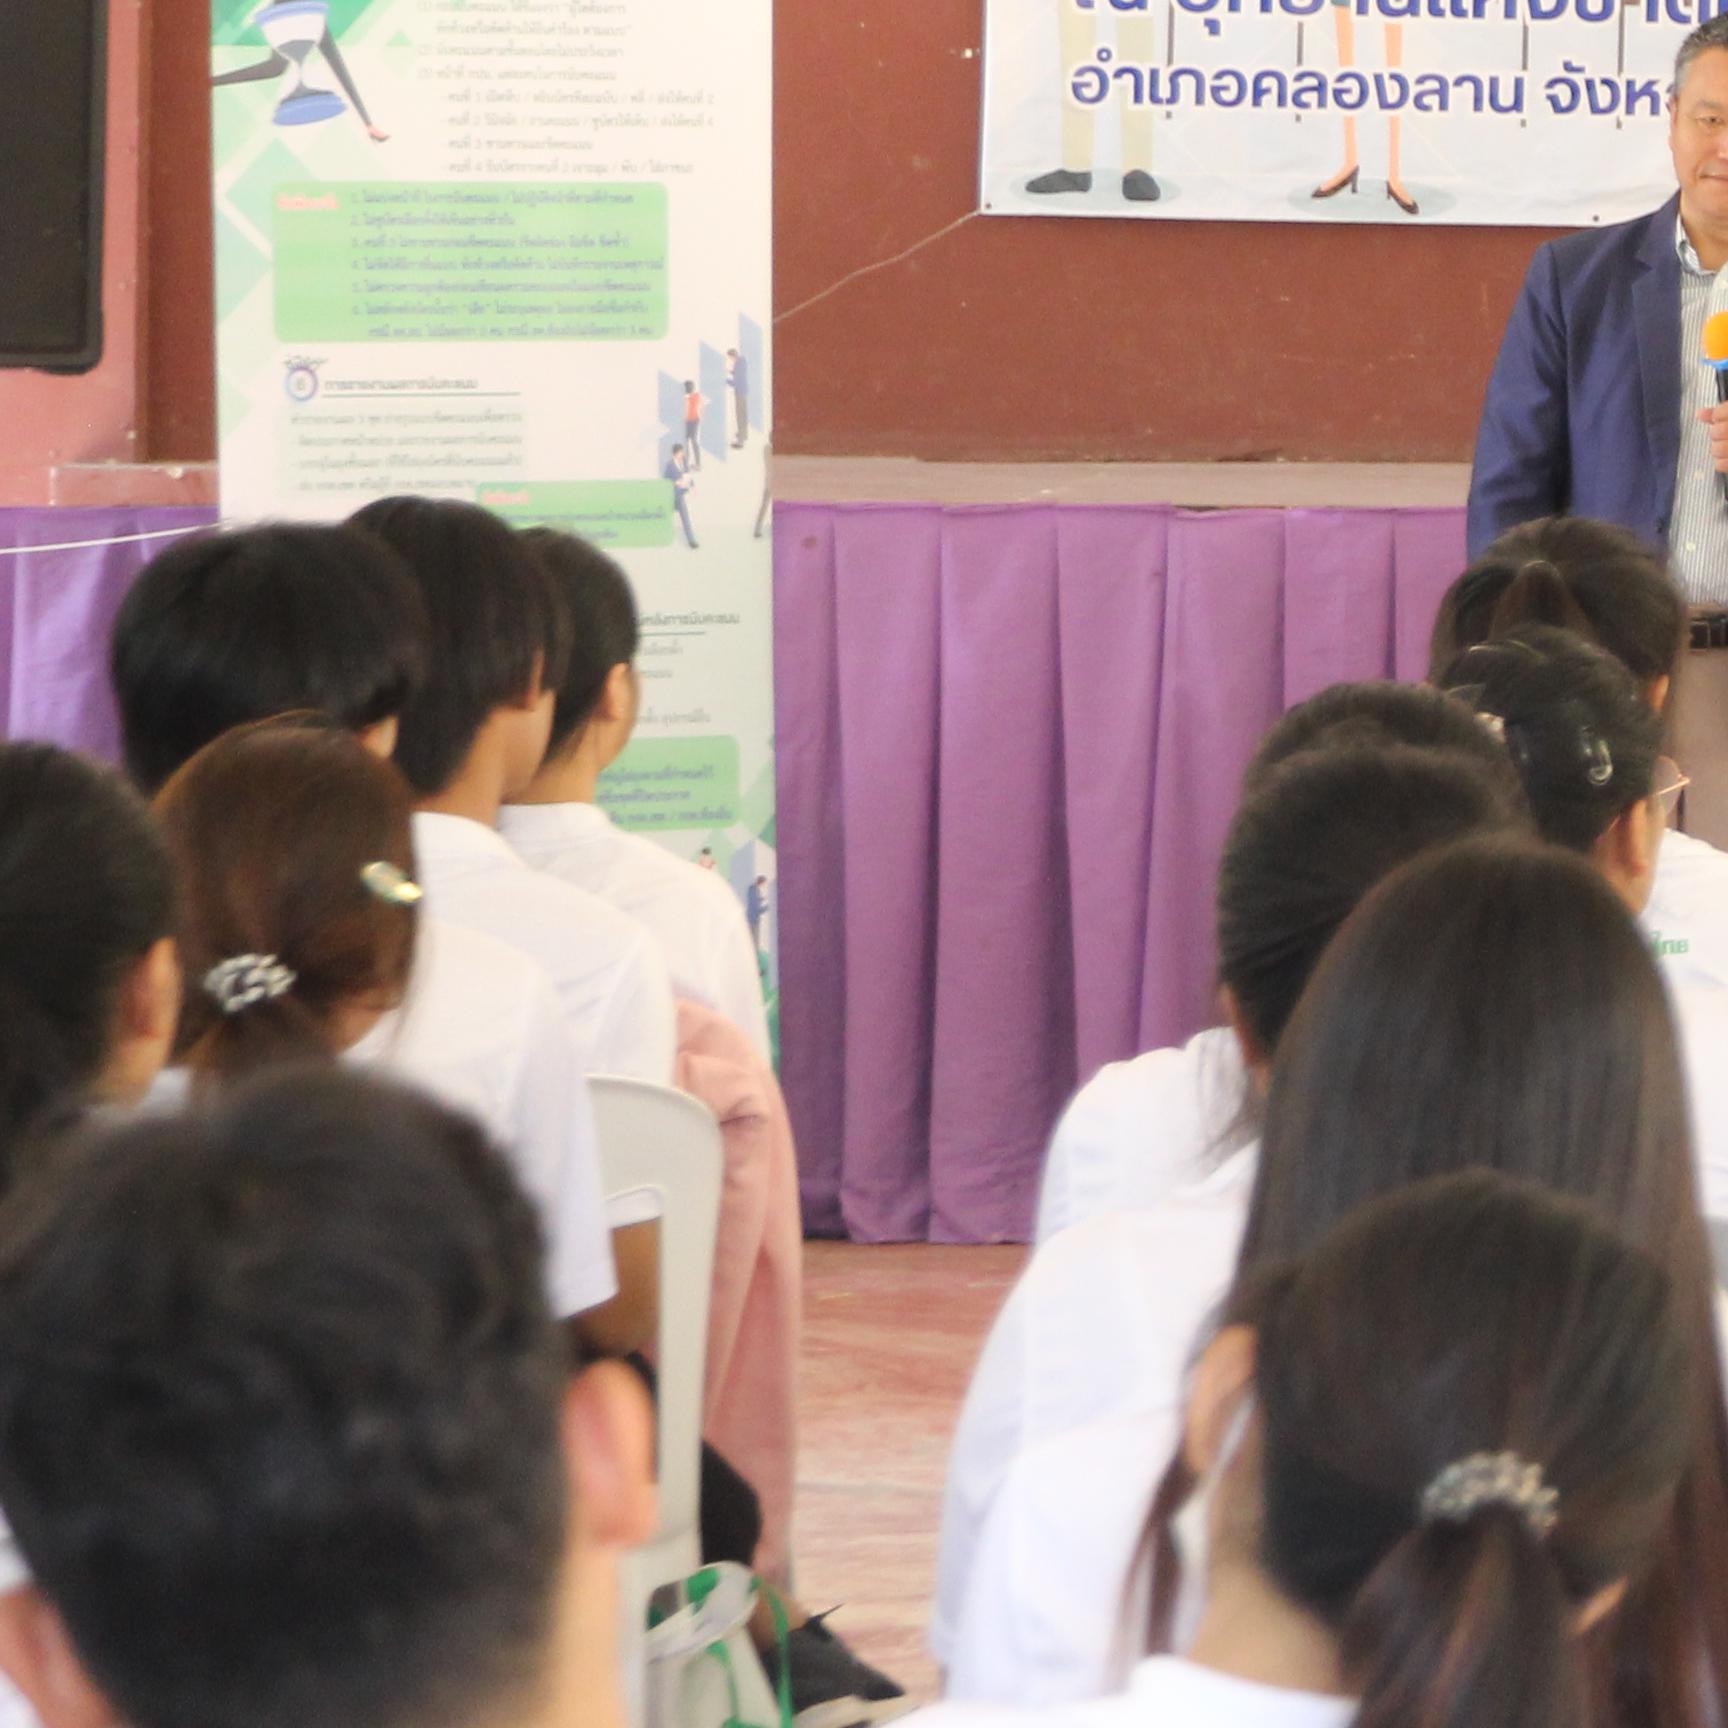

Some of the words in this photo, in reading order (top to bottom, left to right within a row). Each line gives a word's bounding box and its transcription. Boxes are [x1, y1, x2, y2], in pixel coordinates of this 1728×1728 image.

[1072, 46, 1525, 117] อำเภอคลองลาน
